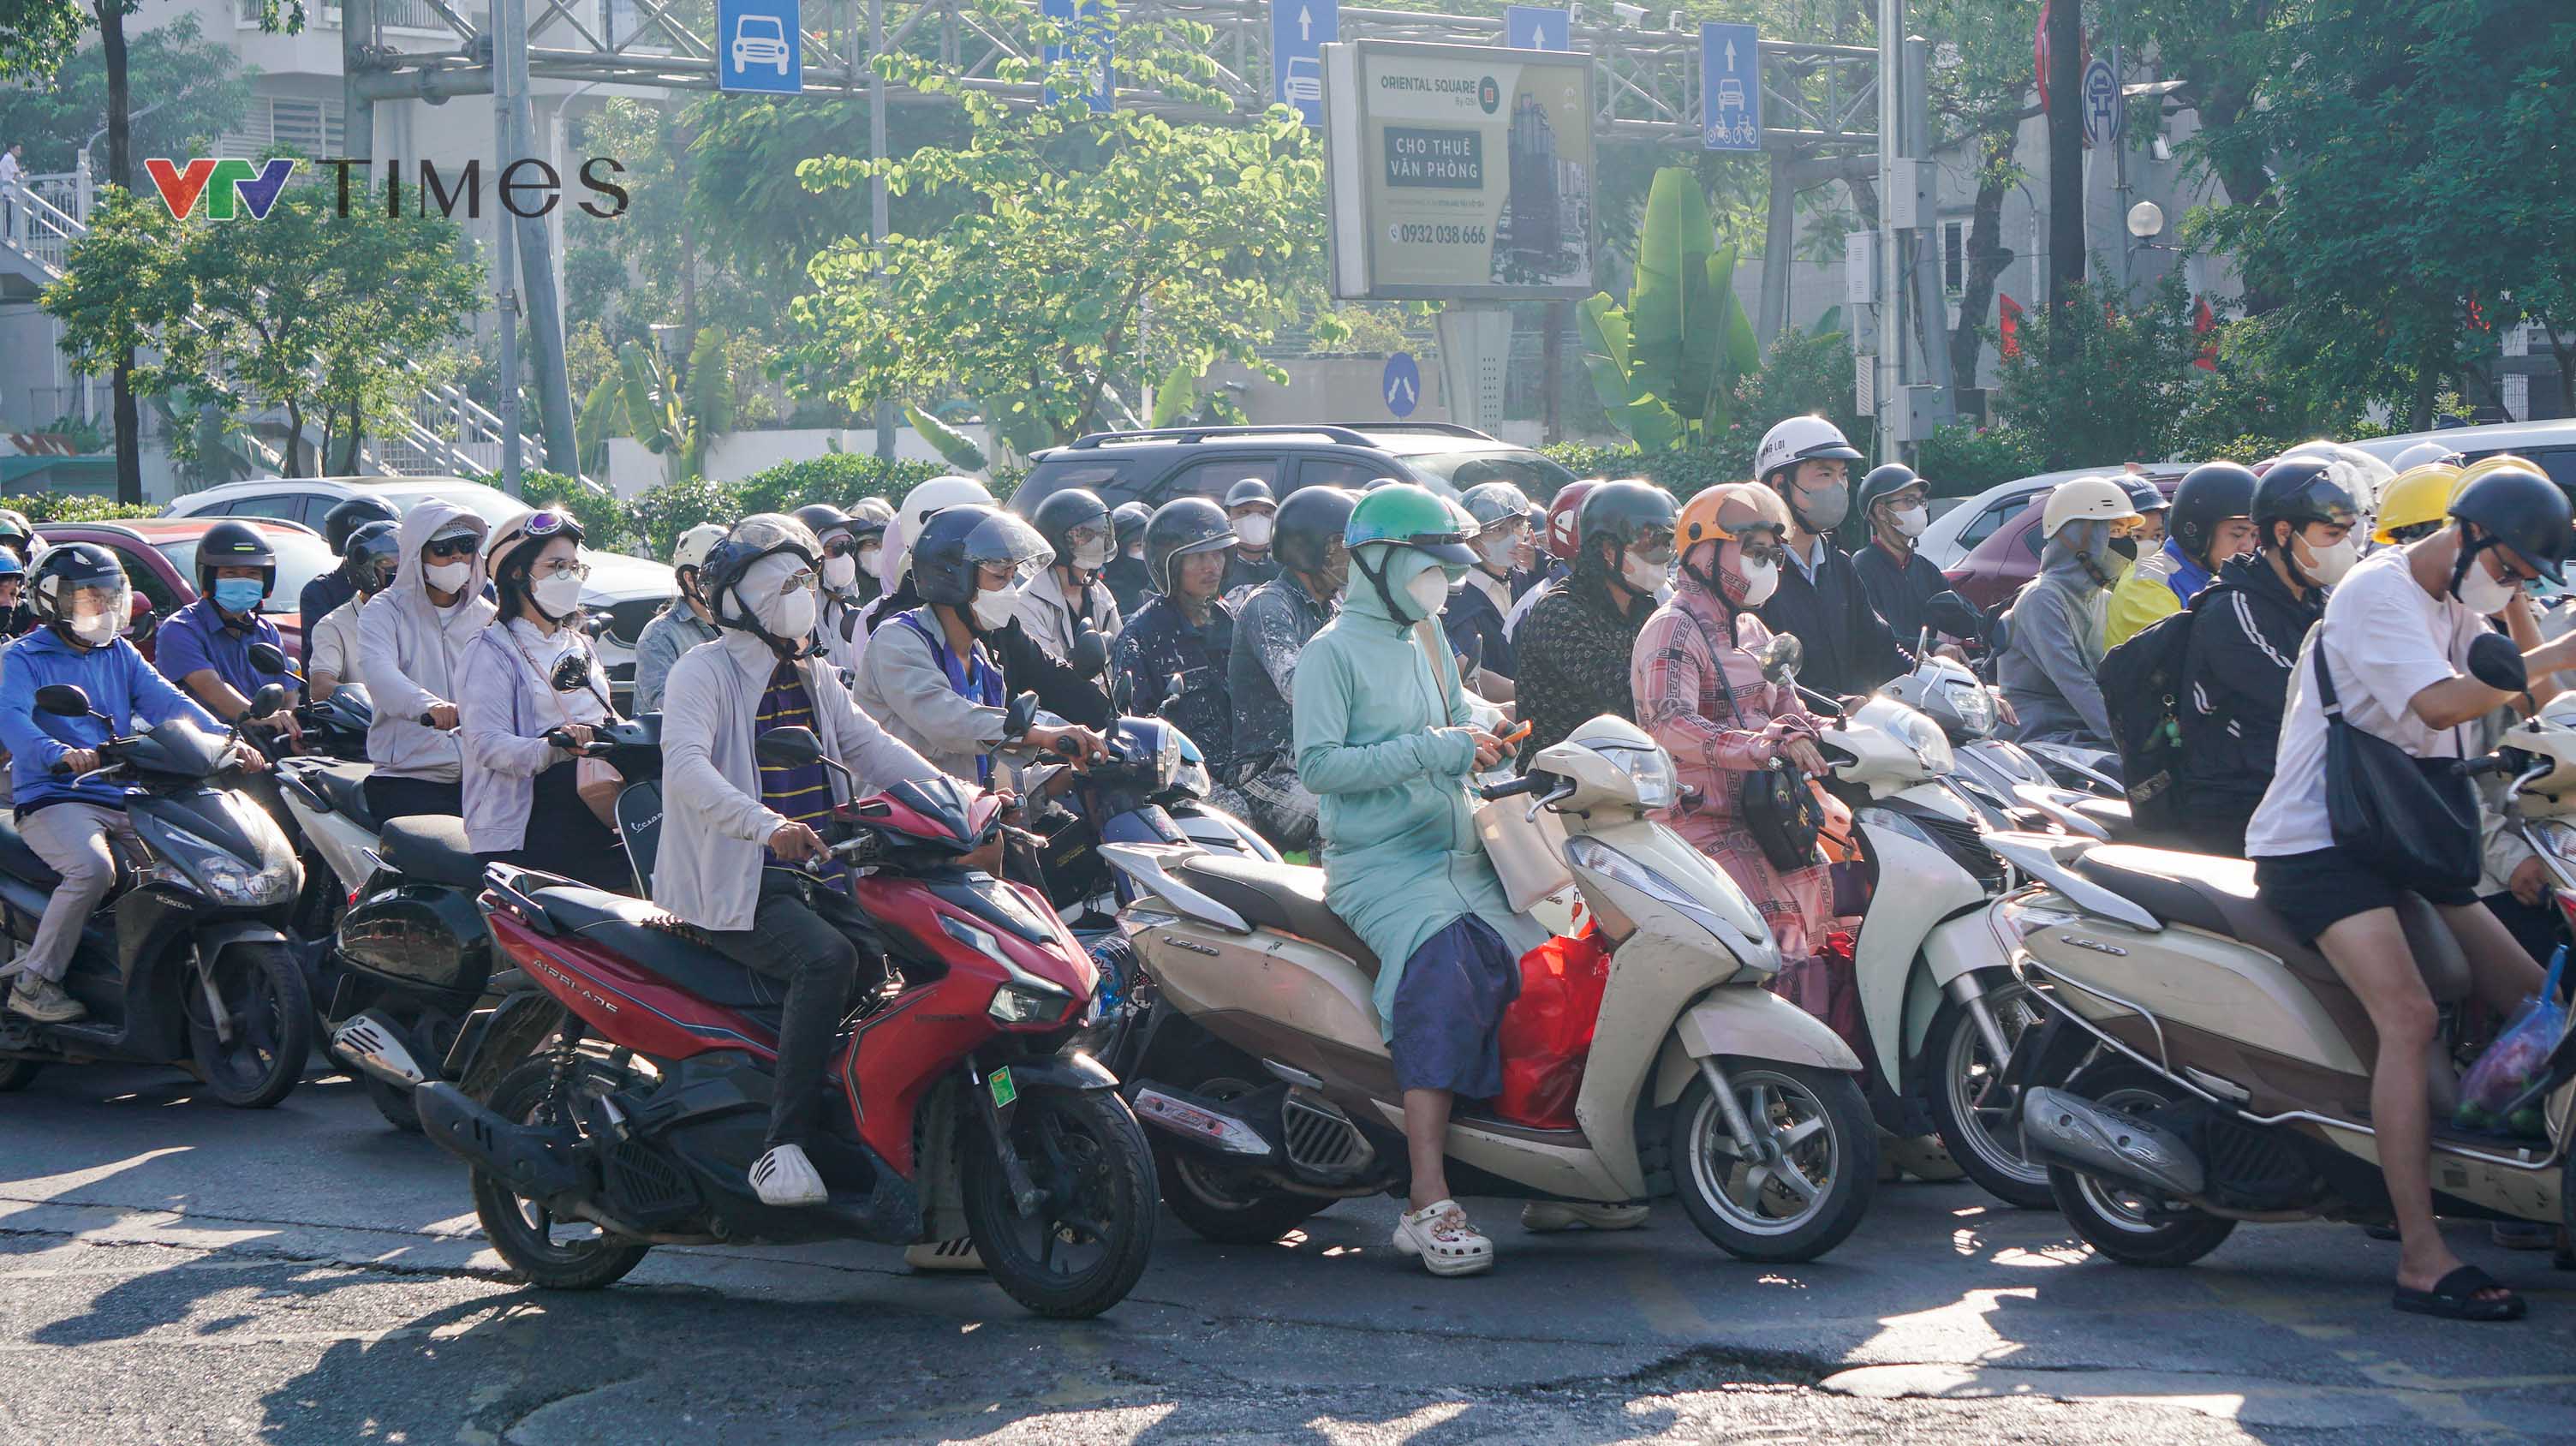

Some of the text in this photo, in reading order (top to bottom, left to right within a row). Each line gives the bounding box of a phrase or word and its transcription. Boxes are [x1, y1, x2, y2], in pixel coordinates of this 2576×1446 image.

[1381, 75, 1476, 93] ORIENTAL SQUARE
[1397, 137, 1470, 156] CHO THUÊ
[1390, 158, 1477, 178] VĂN PHÒNG
[1401, 224, 1486, 245] 0932 038 666
[1163, 935, 1219, 956] LEAD
[2061, 935, 2129, 956] LEAD
